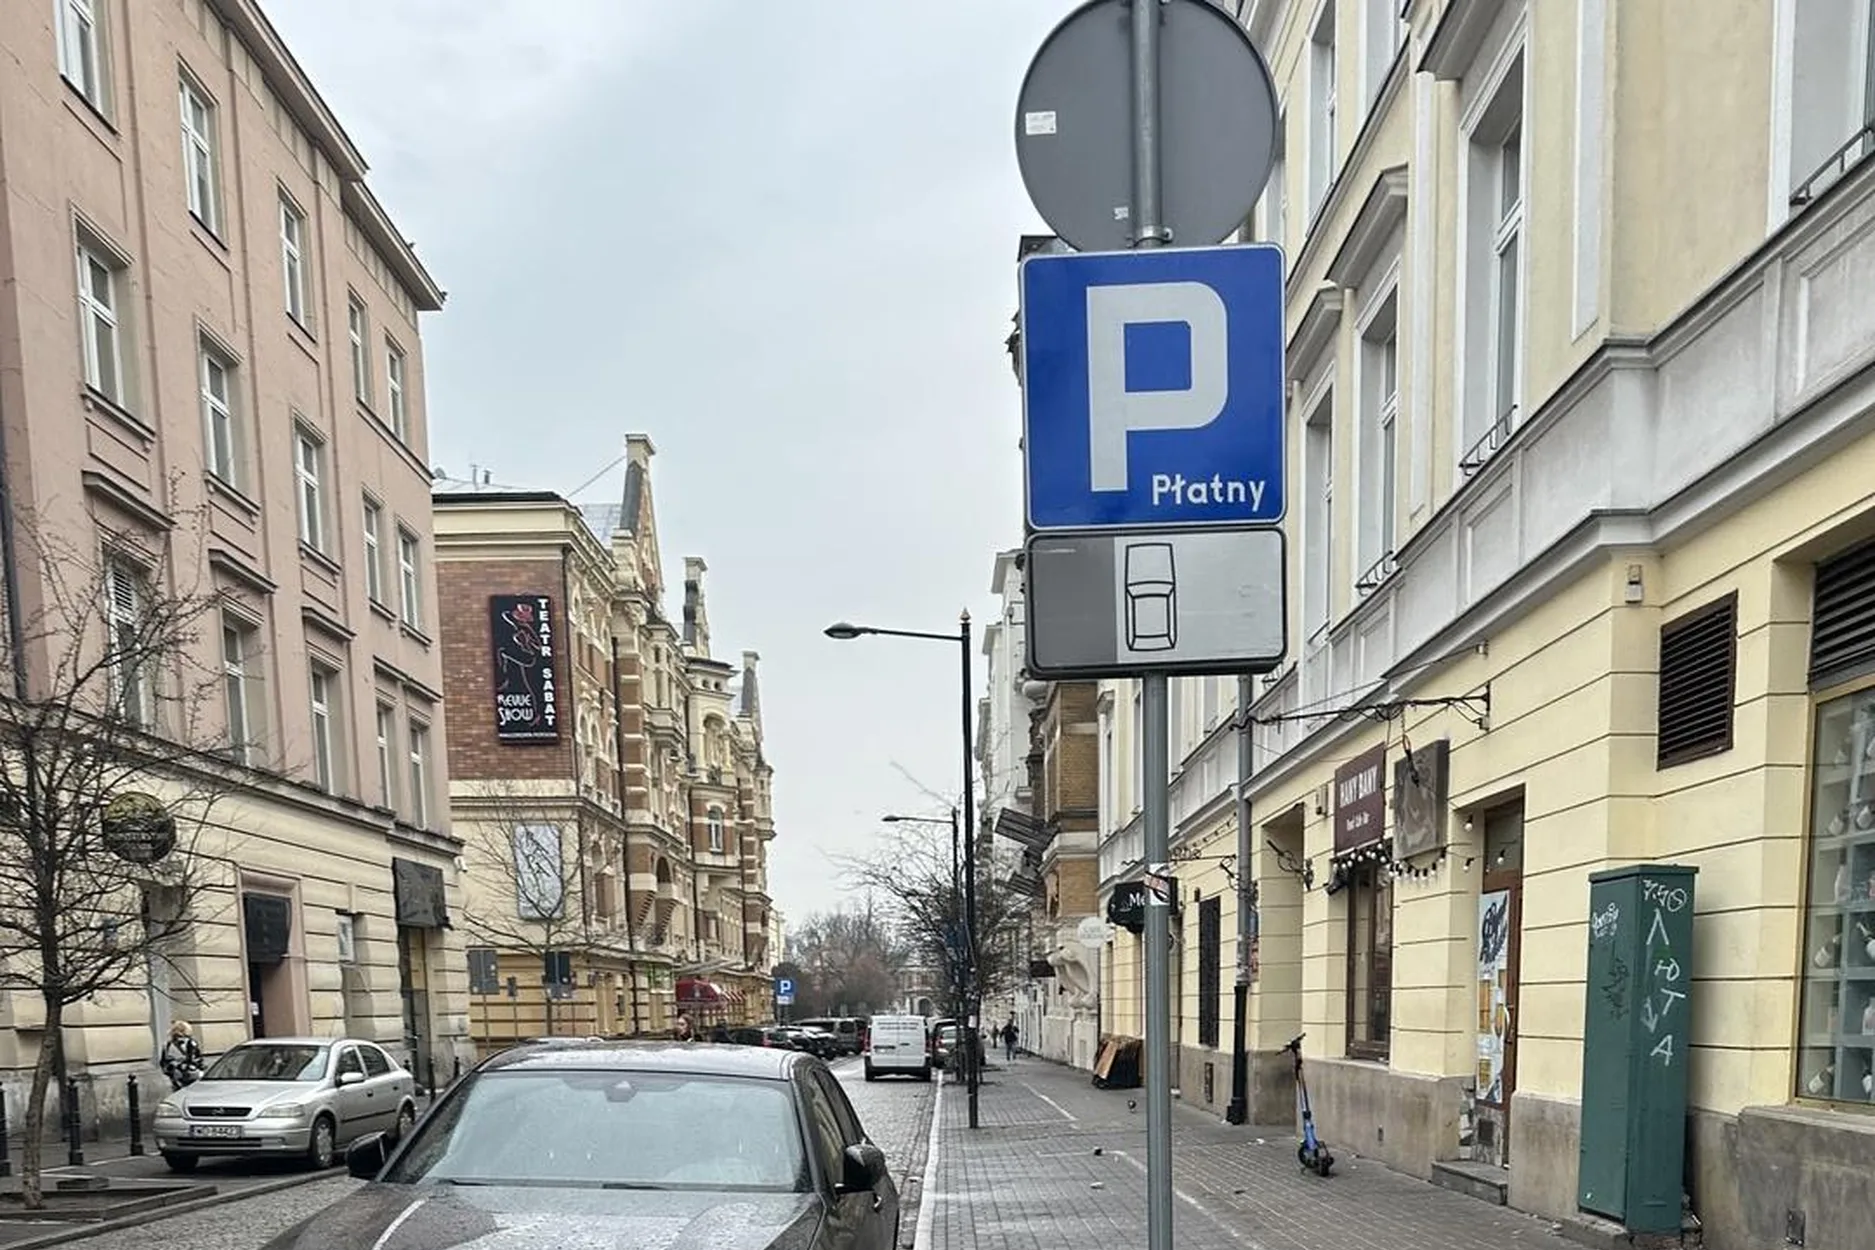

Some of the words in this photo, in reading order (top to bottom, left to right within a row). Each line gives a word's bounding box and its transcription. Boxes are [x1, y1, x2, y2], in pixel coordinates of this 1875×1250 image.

[1086, 281, 1228, 492] P
[1152, 473, 1265, 512] Płatny
[538, 598, 552, 657] TEATR
[497, 694, 532, 707] REVUE
[542, 668, 556, 726] SABAT
[780, 979, 792, 994] P
